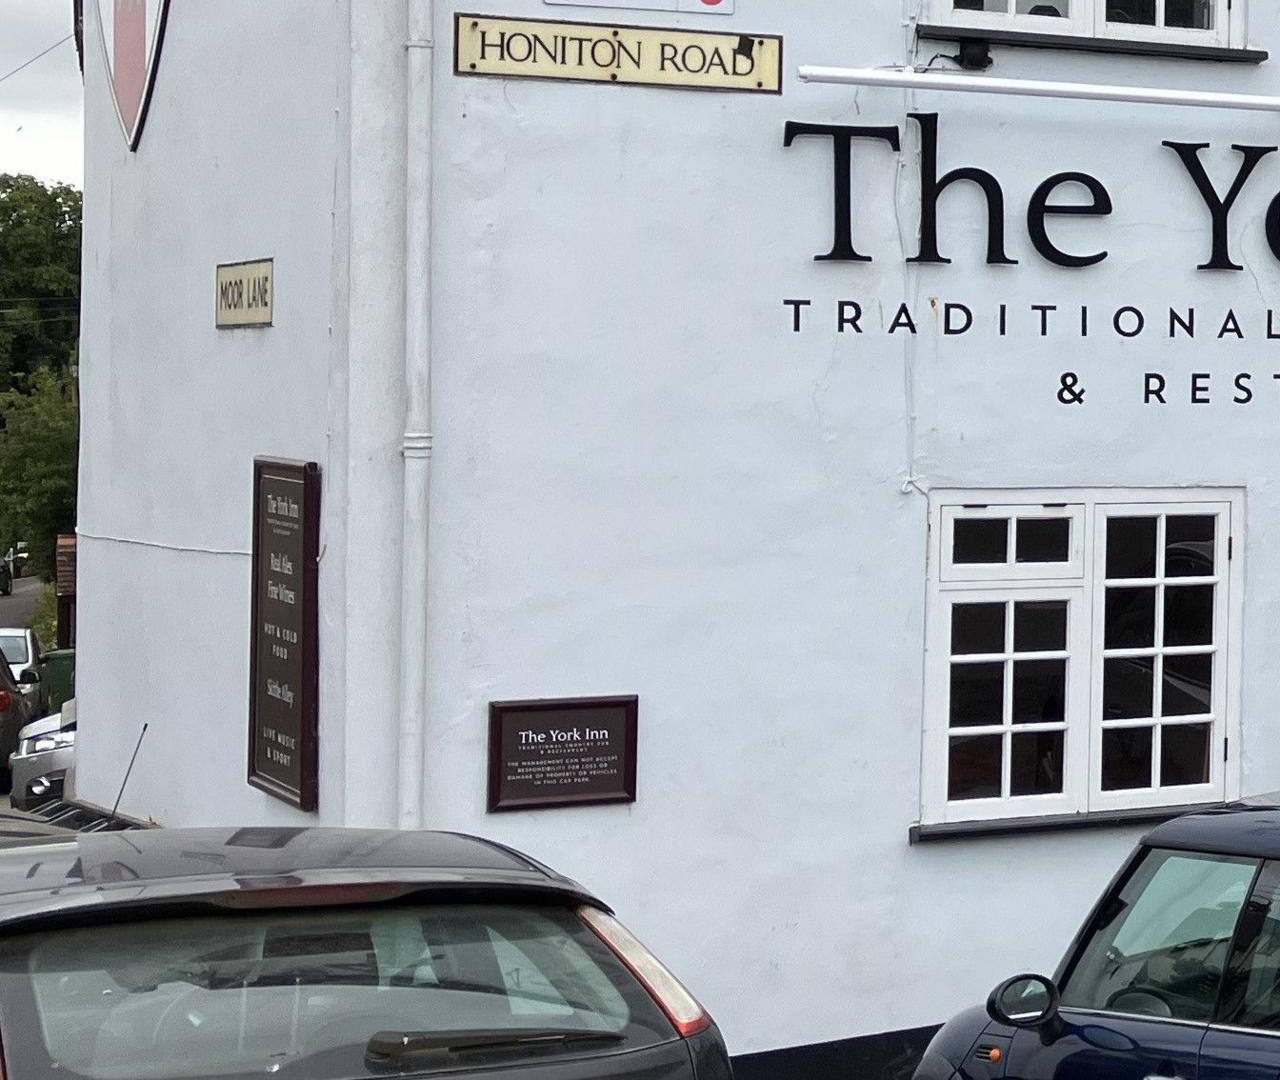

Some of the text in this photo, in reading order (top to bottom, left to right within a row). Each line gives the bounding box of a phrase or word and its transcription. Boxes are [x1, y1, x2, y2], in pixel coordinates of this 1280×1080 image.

[479, 30, 754, 76] HONITON ROAD
[784, 112, 1113, 268] The
[220, 276, 268, 311] MOOR LANE
[1056, 372, 1085, 405] &
[518, 727, 609, 744] The York Inn
